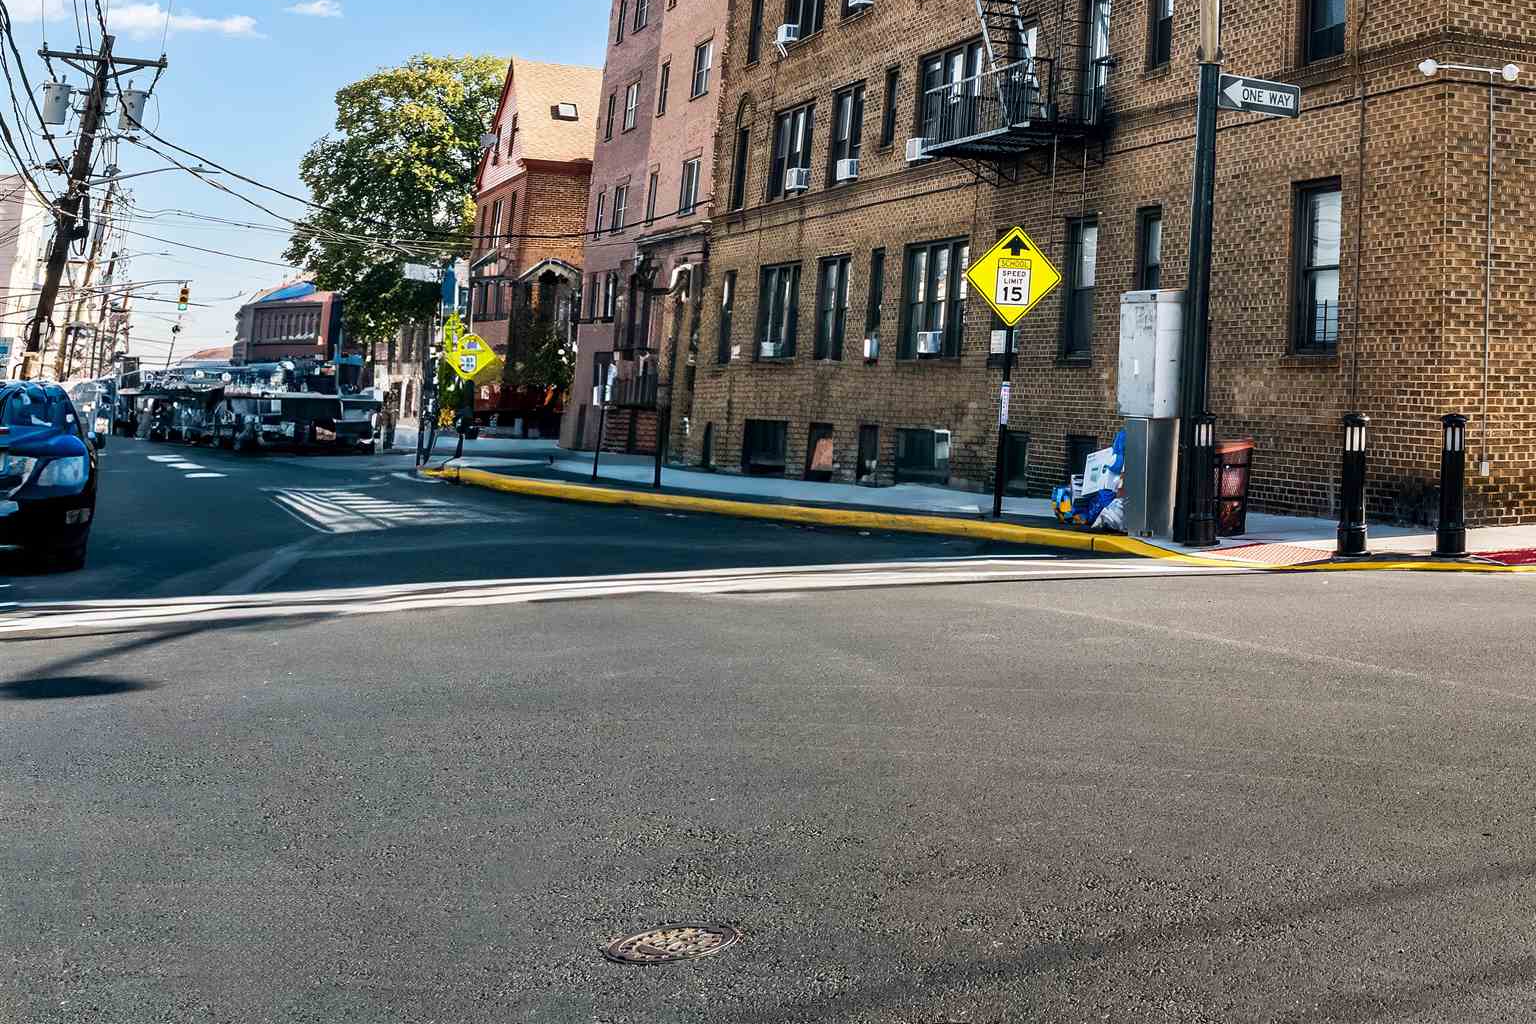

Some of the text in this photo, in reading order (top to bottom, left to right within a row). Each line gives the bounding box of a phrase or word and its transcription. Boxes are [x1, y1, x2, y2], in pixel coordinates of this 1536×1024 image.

[1242, 88, 1291, 107] ONE WAY
[1001, 260, 1028, 268] SCHOOL
[1003, 286, 1022, 302] 15
